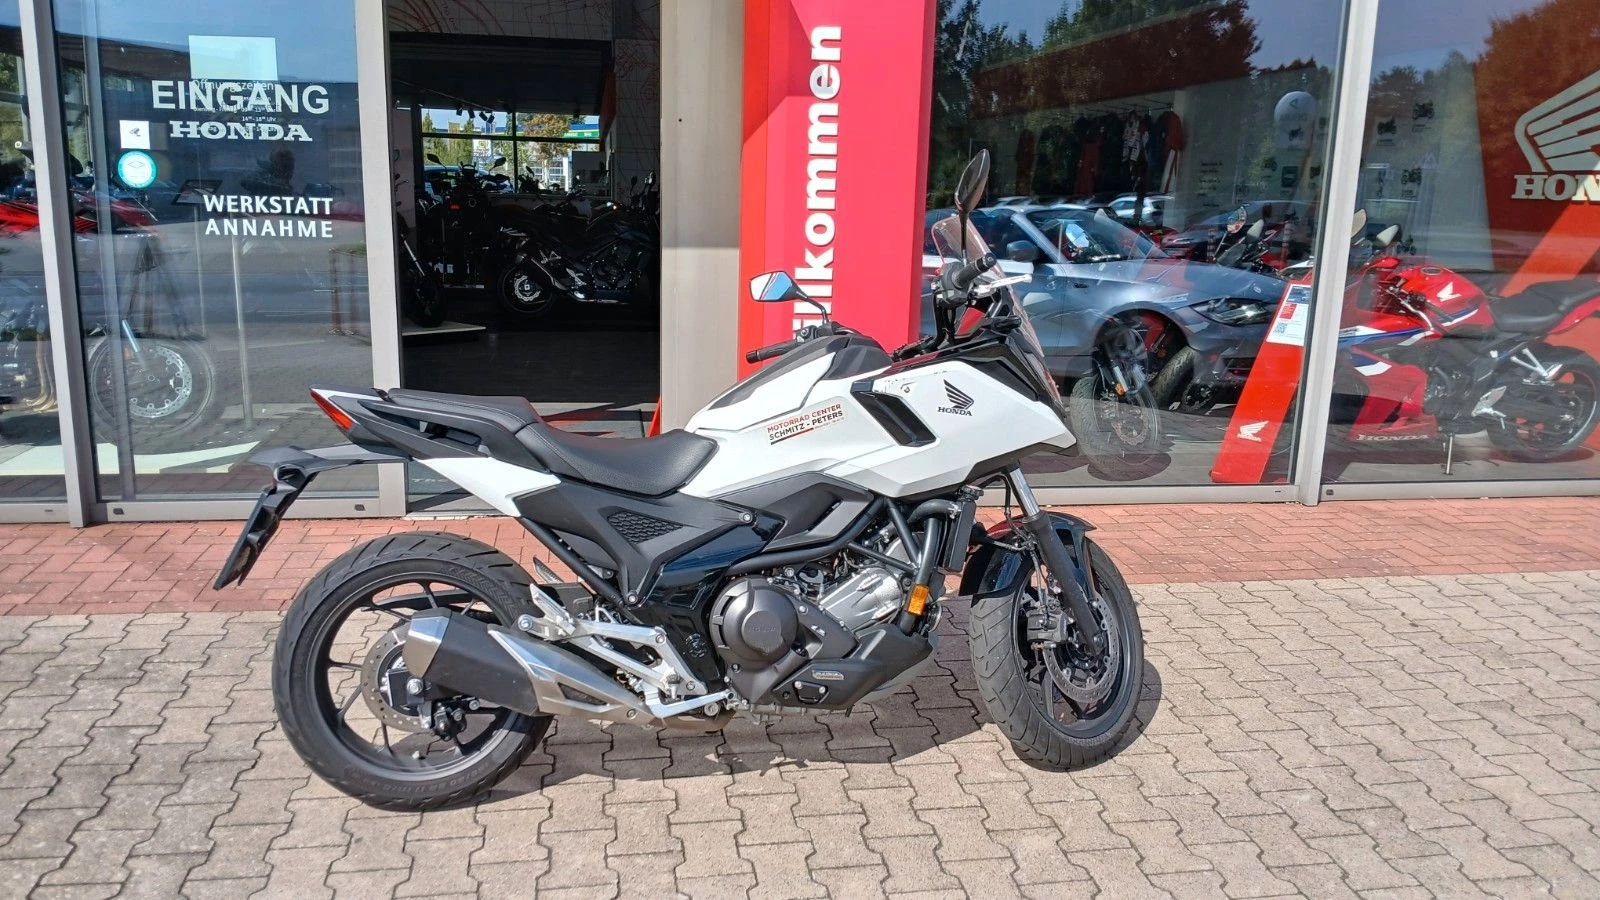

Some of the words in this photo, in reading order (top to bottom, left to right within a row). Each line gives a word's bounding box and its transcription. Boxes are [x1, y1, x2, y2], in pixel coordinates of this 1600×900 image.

[151, 80, 330, 114] EINGANG
[169, 120, 313, 142] HONDA
[792, 25, 843, 341] illkommen
[1511, 173, 1600, 202] HON
[203, 195, 334, 215] WERKSTATT
[204, 218, 333, 238] ANNAHME
[767, 414, 810, 433] MOTORRAD
[811, 403, 841, 418] CENTER
[769, 423, 805, 441] SCHMITZ
[811, 410, 844, 426] PETERS
[937, 406, 973, 417] HONDA
